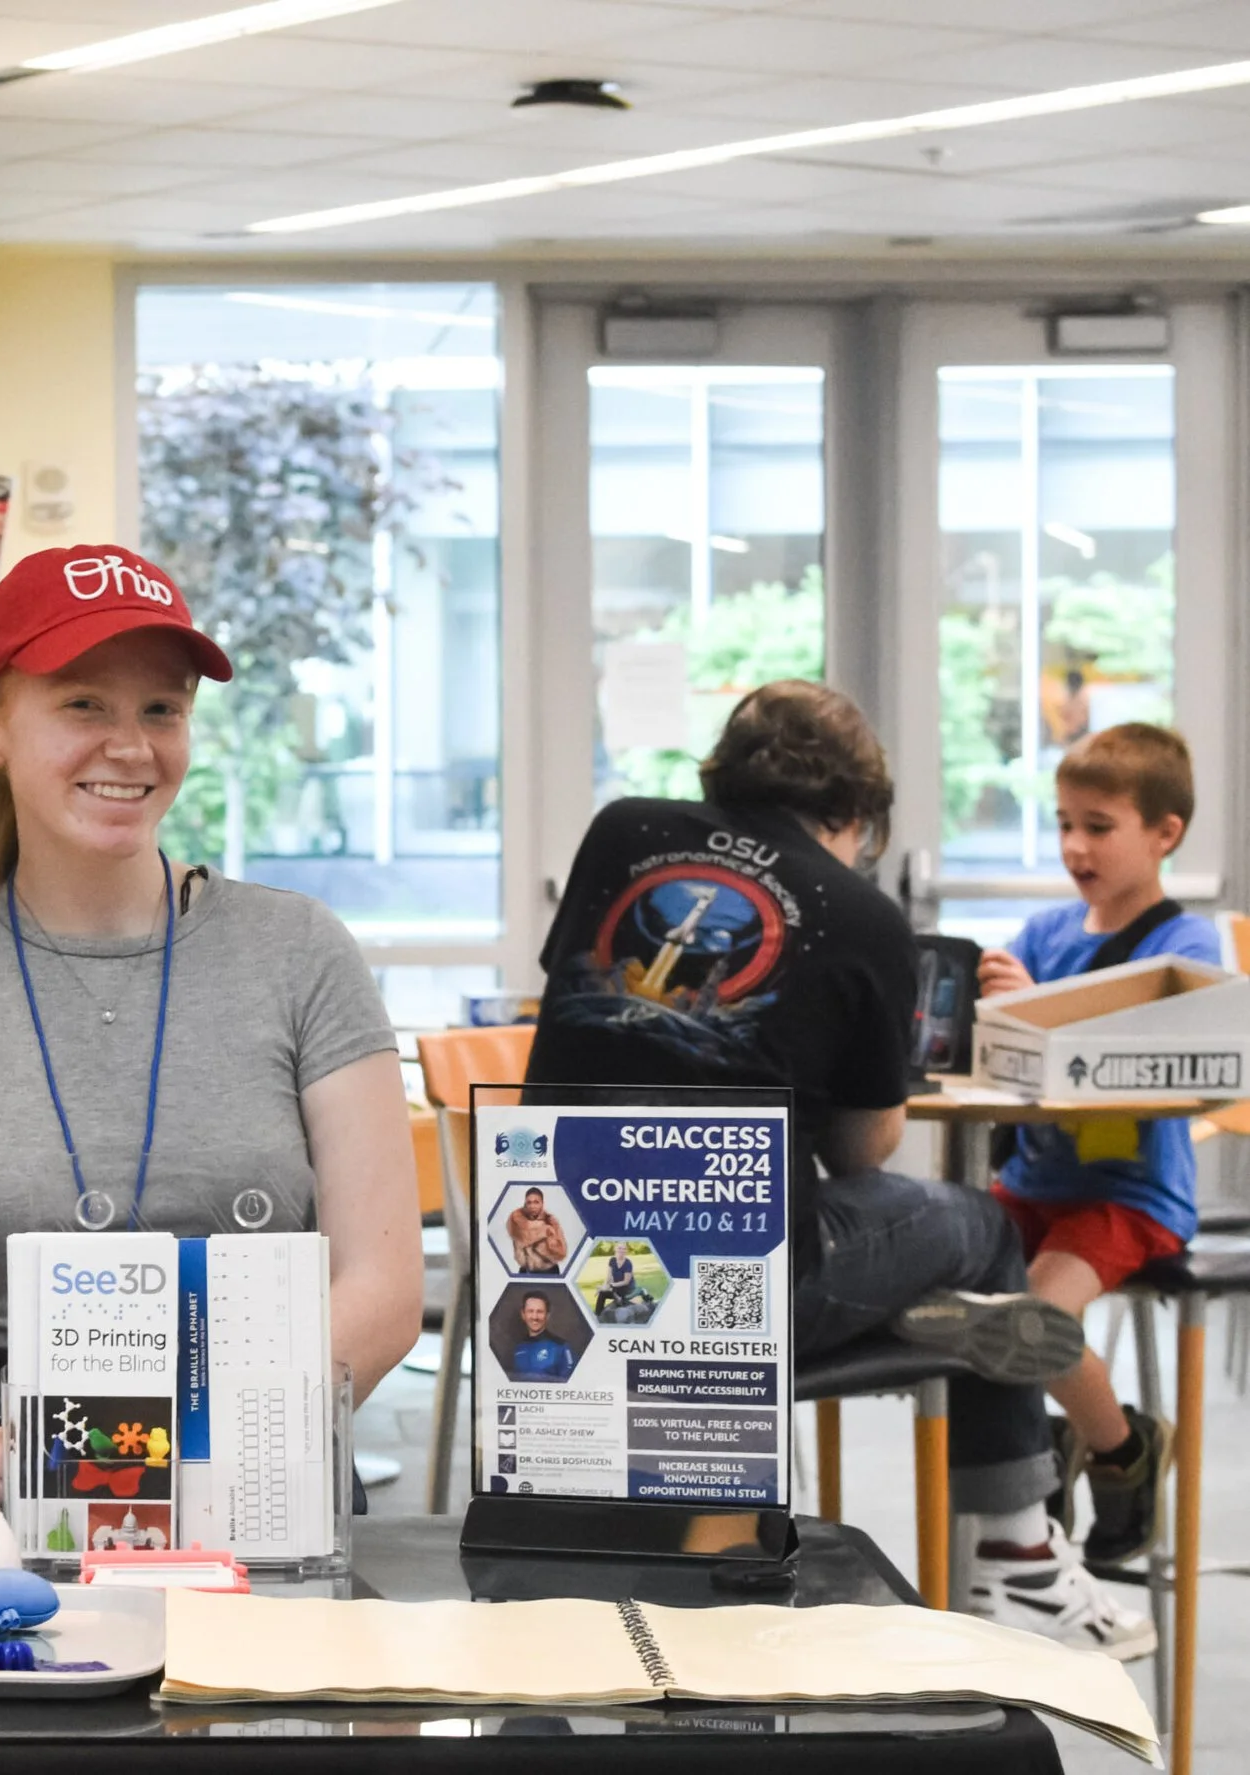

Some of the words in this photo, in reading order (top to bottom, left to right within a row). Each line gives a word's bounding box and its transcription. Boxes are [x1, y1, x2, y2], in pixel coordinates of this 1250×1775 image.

[63, 555, 172, 606] Ohio
[707, 831, 779, 867] OSU
[1094, 1053, 1241, 1089] BATTLESHIP
[620, 1125, 771, 1150] SCIACCESS
[495, 1159, 548, 1168] SciAccess
[704, 1153, 771, 1176] 2024
[581, 1178, 771, 1203] CONFERENCE
[624, 1211, 678, 1231] MAY
[684, 1211, 712, 1231] 10
[718, 1212, 734, 1232] &
[742, 1212, 768, 1232] 11
[52, 1262, 167, 1295] See3D
[189, 1292, 198, 1344] ALPHABET
[51, 1328, 80, 1347] 3D
[88, 1328, 166, 1351] Printing
[608, 1339, 655, 1354] SCAN
[661, 1340, 685, 1355] TO
[690, 1341, 778, 1357] REGISTER!
[51, 1353, 78, 1372] for
[83, 1353, 113, 1373] the
[119, 1354, 166, 1373] Blind
[190, 1347, 199, 1389] BRAILLE
[638, 1368, 685, 1379] SHAPING
[686, 1369, 706, 1379] THE
[708, 1370, 749, 1380] FUTURE
[750, 1371, 765, 1381] OF
[496, 1389, 552, 1400] KEYNOTE
[555, 1390, 614, 1401] SPEAKERS
[637, 1384, 693, 1394] DISABILITY
[694, 1386, 767, 1396] ACCESSIBILITY
[190, 1392, 199, 1412] THE
[535, 1428, 567, 1436] ASHLEY
[569, 1429, 595, 1437] SHEW
[633, 1418, 659, 1427] 100%
[707, 1420, 732, 1429] FREE
[734, 1421, 743, 1430] &
[743, 1421, 772, 1431] OPEN
[665, 1431, 679, 1440] TO
[682, 1431, 701, 1441] THE
[703, 1432, 740, 1442] PUBLIC
[519, 1456, 532, 1464] DR.
[535, 1456, 560, 1465] CHRIS
[658, 1461, 708, 1472] INCREASE
[710, 1463, 747, 1474] SKILLS,
[663, 1474, 731, 1485] KNOWLEDGE
[733, 1477, 741, 1485] &
[639, 1486, 723, 1497] OPPORTUNITIES
[724, 1488, 736, 1498] IN
[738, 1489, 767, 1498] STEM
